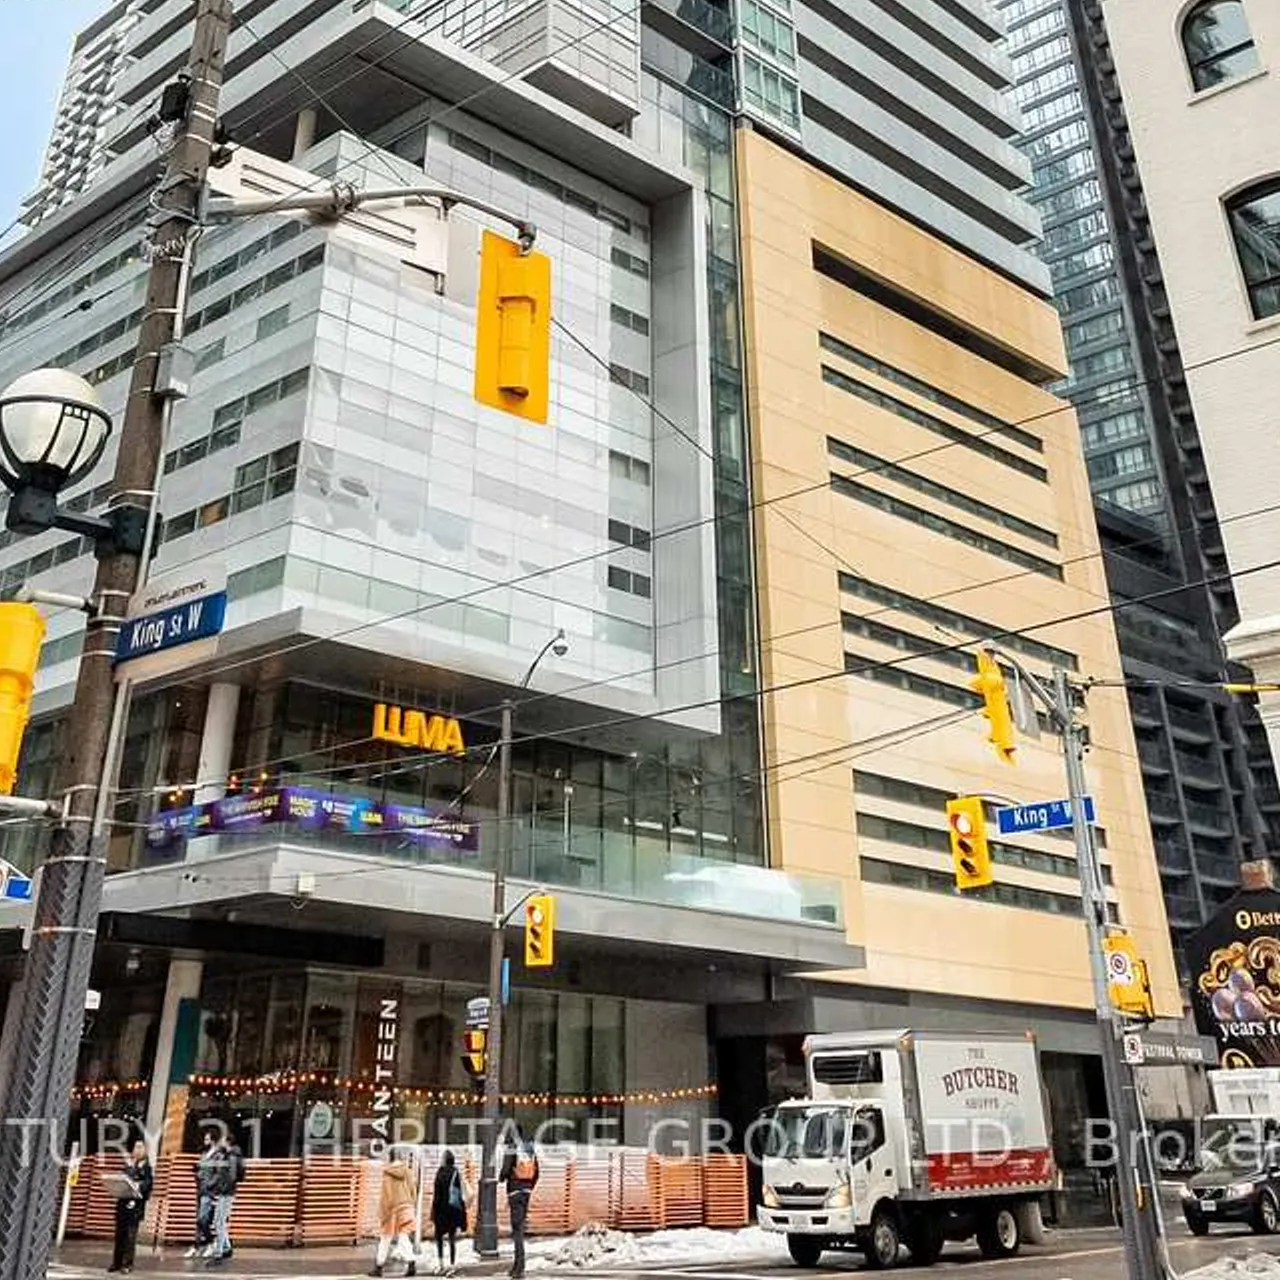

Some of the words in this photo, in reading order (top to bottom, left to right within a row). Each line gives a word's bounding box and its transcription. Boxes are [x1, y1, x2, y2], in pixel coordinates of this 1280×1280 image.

[130, 617, 165, 651] King
[169, 614, 183, 637] St
[187, 602, 204, 632] W
[372, 703, 467, 757] LUMA
[1013, 807, 1048, 828] King
[1220, 1020, 1266, 1042] years
[942, 1066, 1019, 1097] BUTCHER
